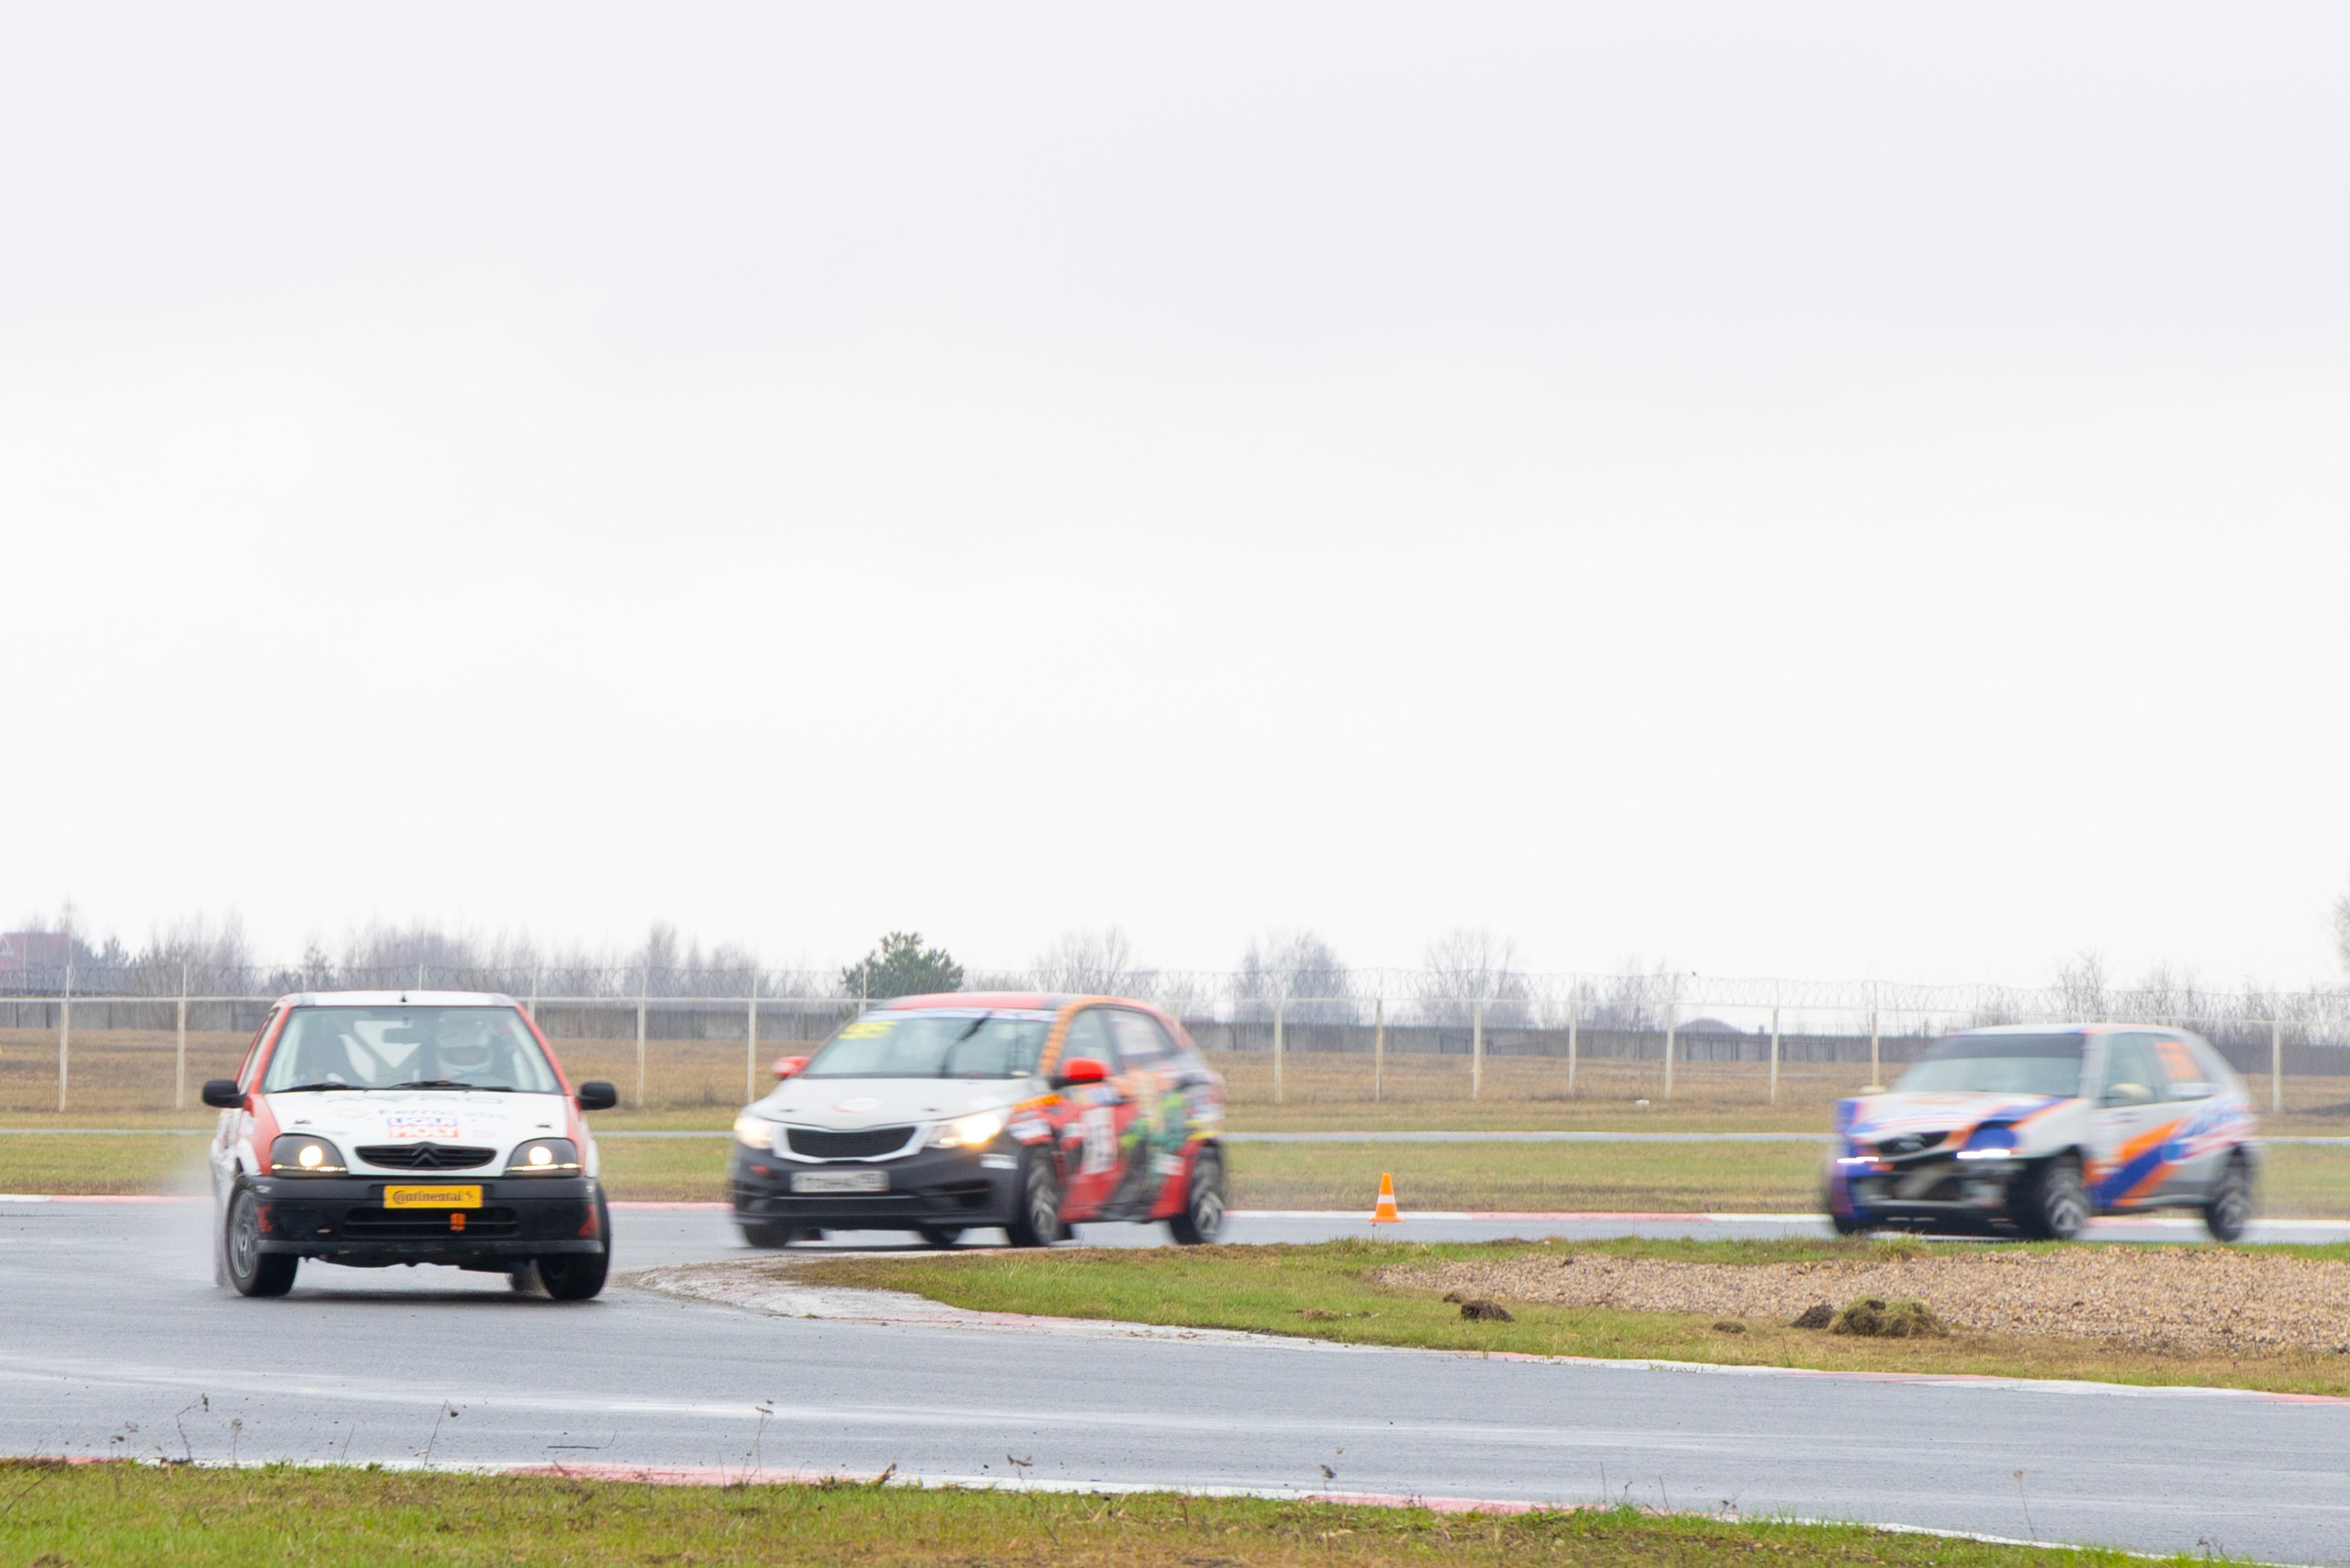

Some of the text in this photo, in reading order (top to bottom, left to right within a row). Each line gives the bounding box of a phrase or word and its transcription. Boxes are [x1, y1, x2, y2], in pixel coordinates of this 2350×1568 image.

[390, 1117, 455, 1126] LIQUI
[392, 1126, 457, 1137] MOLY
[392, 1191, 462, 1204] Continental
